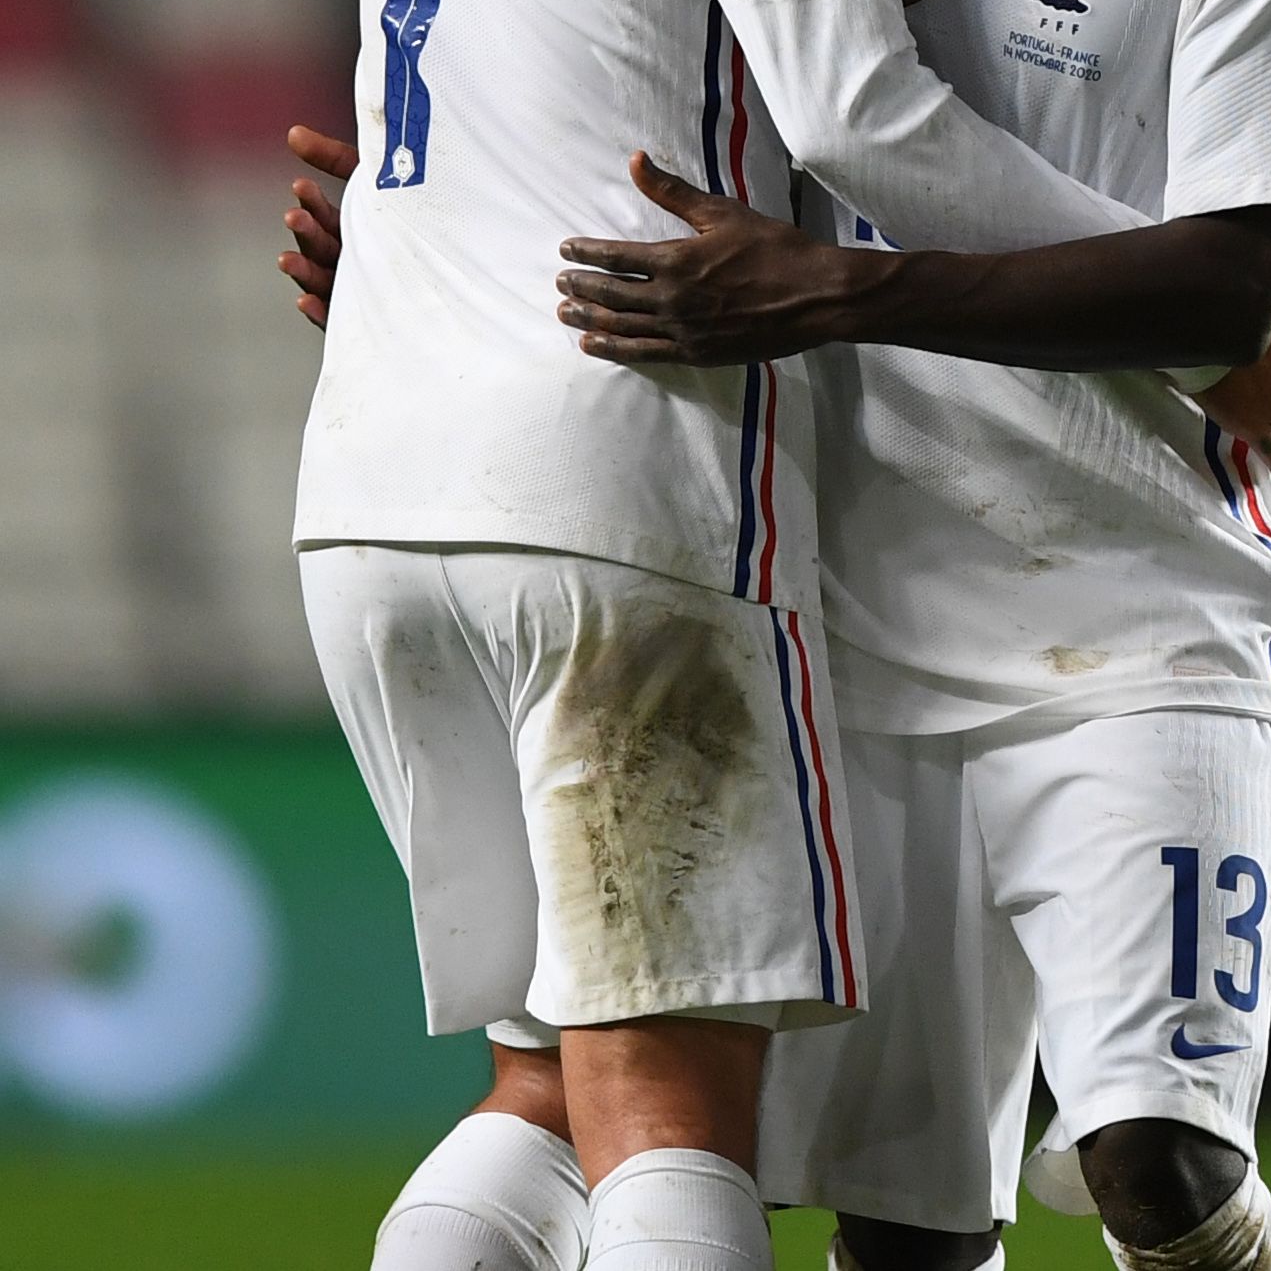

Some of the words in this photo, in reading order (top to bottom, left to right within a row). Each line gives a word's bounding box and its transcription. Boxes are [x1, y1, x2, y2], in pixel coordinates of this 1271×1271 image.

[1003, 44, 1013, 59] 14
[1014, 49, 1067, 74] NOVEMBRE
[1069, 64, 1102, 82] 2020
[1161, 846, 1267, 1013] 13
